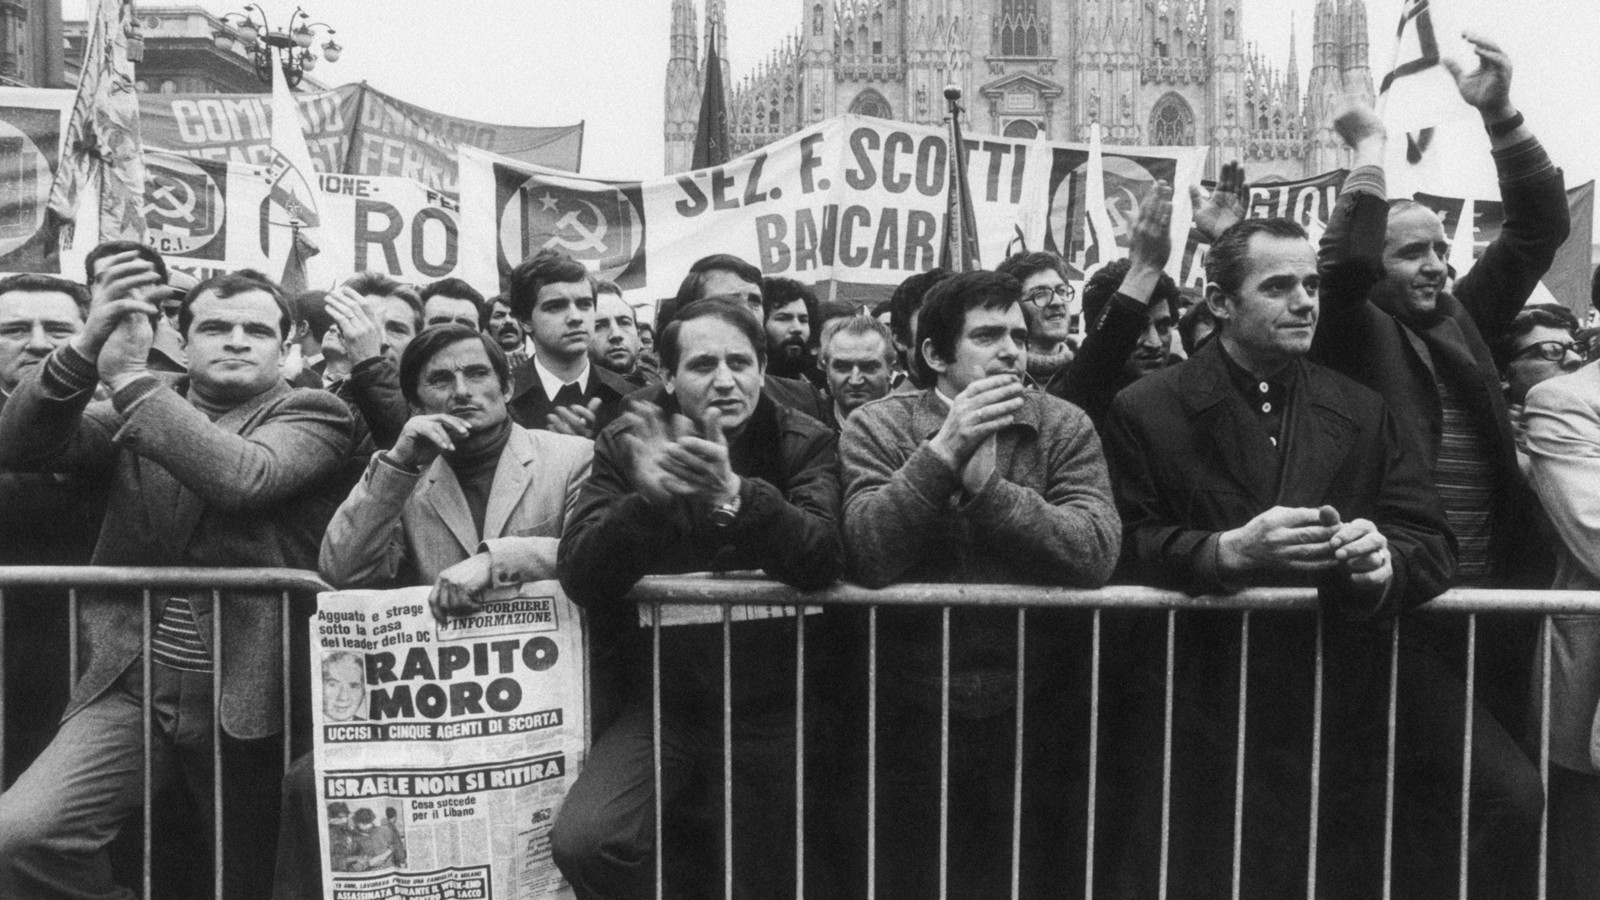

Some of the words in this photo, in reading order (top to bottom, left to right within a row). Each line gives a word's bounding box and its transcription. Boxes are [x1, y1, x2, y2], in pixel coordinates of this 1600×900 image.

[675, 152, 782, 218] SEZ.
[800, 132, 831, 194] F.
[318, 610, 366, 623] Agguato
[371, 613, 379, 622] e
[386, 604, 423, 619] strage
[485, 600, 550, 614] CORRIERE
[319, 623, 350, 635] sotto
[356, 624, 367, 636] la
[372, 621, 402, 636] casa
[342, 637, 378, 650] leader
[381, 632, 413, 647] della
[416, 630, 430, 642] DC
[364, 636, 559, 685] RAPITO
[369, 677, 523, 720] MORO
[328, 726, 371, 740] UCCISI
[388, 725, 432, 739] CINQUE
[436, 721, 482, 739] AGENTI
[489, 718, 502, 733] DI
[508, 712, 559, 731] SCORTA
[328, 776, 409, 798] ISRAELE
[415, 775, 461, 795] NON
[466, 773, 485, 790] SI
[491, 760, 561, 788] RITIRA
[411, 800, 434, 810] Cosa
[437, 796, 476, 808] succede
[412, 811, 428, 822] per
[432, 809, 439, 819] il
[444, 808, 475, 819] Libano
[337, 888, 393, 900] ASSASSINATA
[394, 886, 430, 896] DURANTE
[457, 890, 482, 898] SACCO
